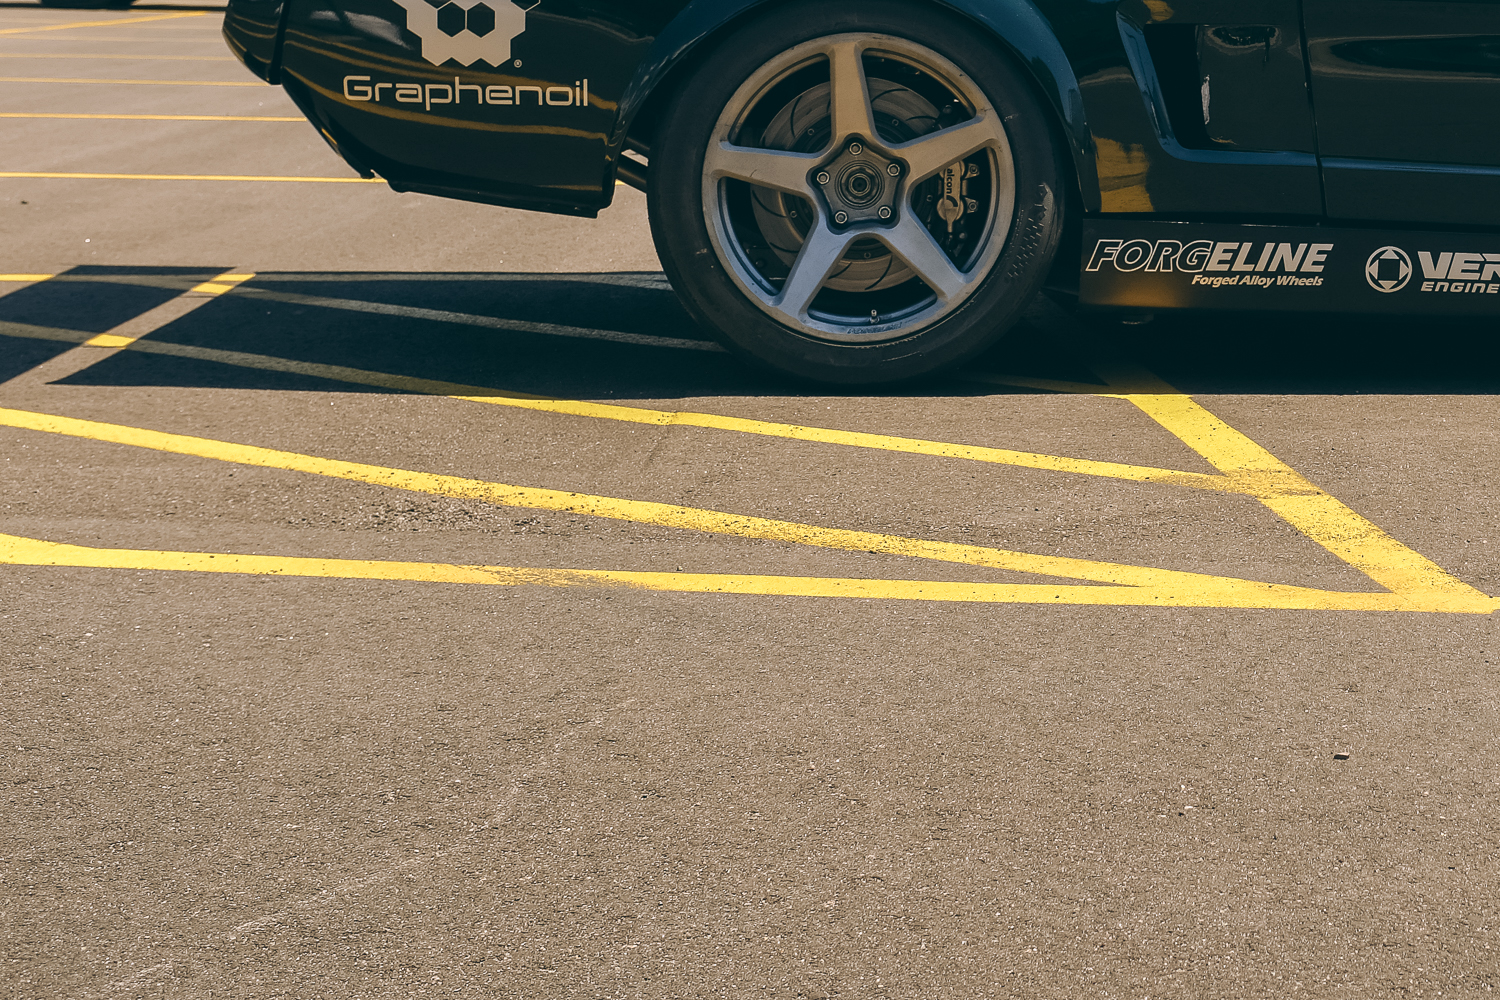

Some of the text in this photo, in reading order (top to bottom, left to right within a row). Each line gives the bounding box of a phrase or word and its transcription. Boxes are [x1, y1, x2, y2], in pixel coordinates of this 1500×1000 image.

[343, 75, 588, 111] Graphenoil
[946, 168, 955, 194] alcon
[1085, 239, 1334, 273] FORGELINE
[1191, 274, 1323, 289] Forged Alloy Wheels
